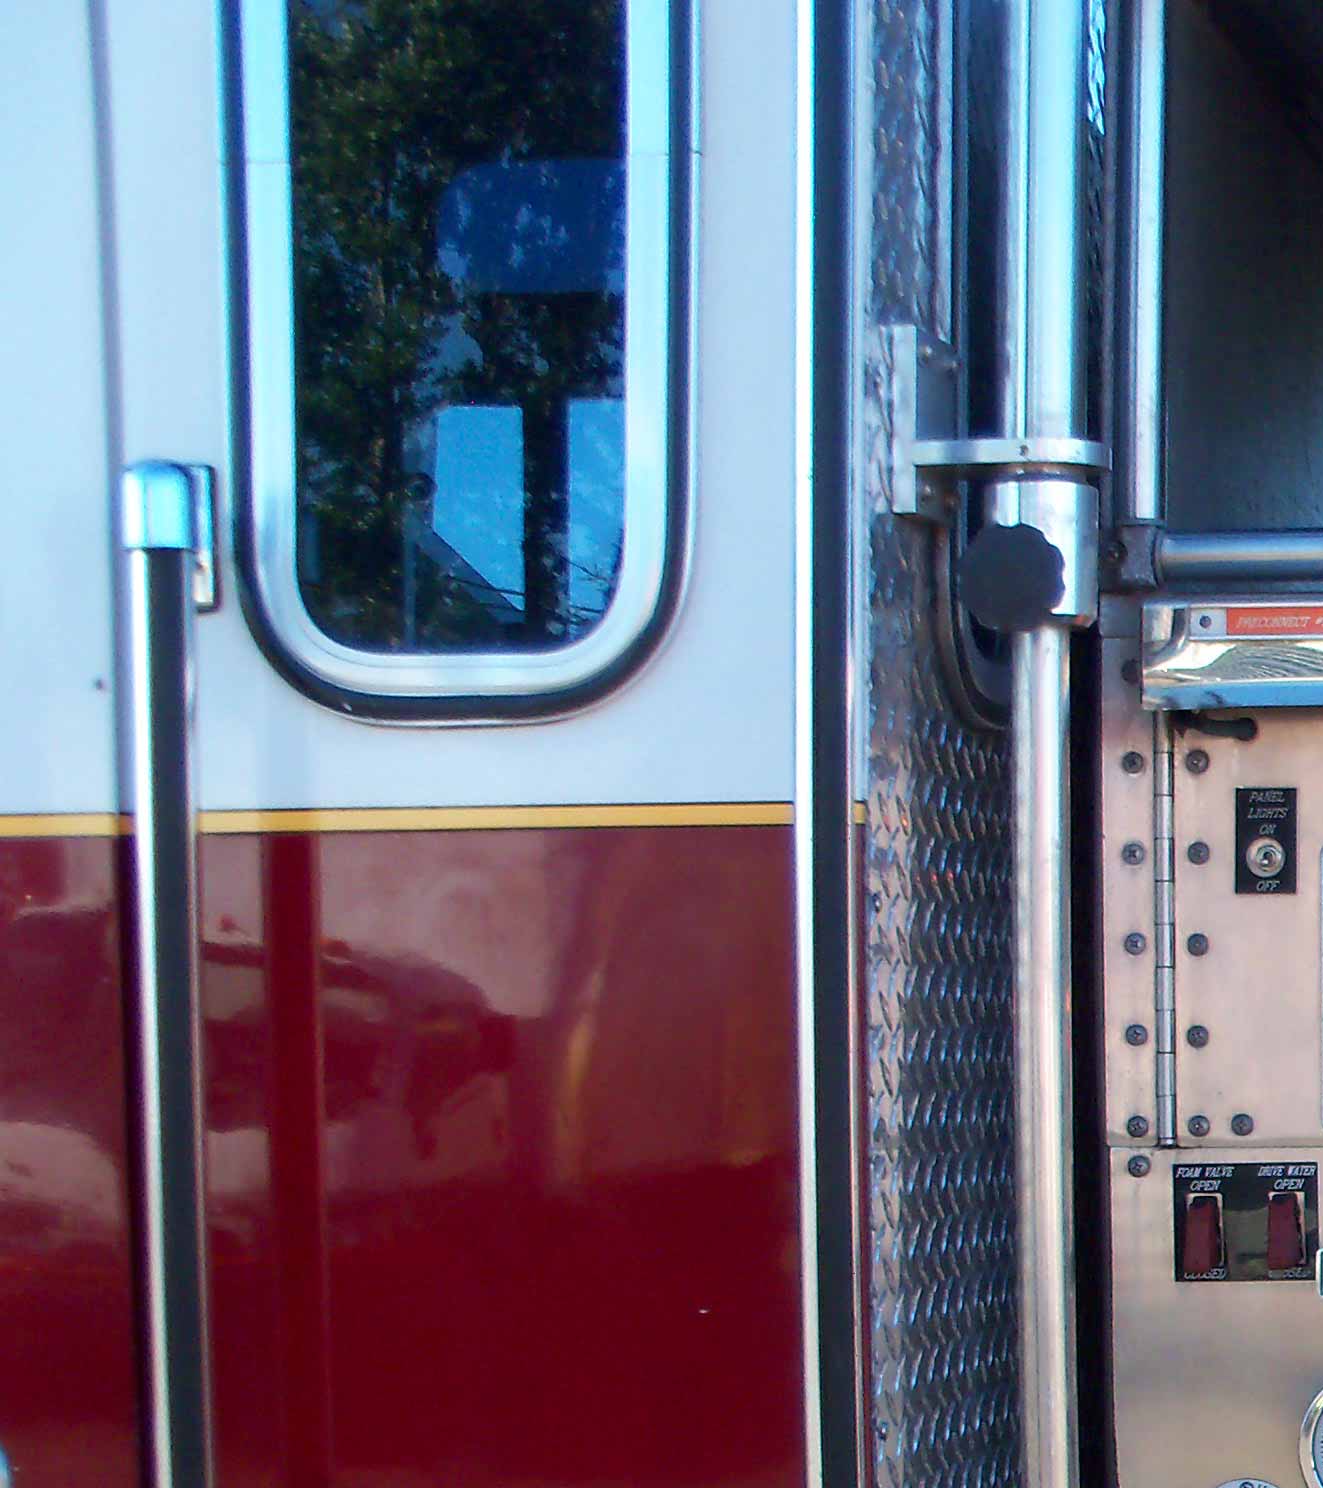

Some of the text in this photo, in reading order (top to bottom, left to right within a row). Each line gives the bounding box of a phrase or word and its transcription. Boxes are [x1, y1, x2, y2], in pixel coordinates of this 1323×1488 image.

[1236, 616, 1310, 628] PRECONNECT
[1249, 791, 1285, 803] PANEL
[1248, 807, 1288, 820] LIGHTS
[1259, 824, 1276, 835] ON
[1256, 880, 1280, 892] OFF
[1175, 1166, 1235, 1178] FOAM VALVE
[1257, 1165, 1316, 1177] DRIVE WATER
[1190, 1180, 1221, 1191] OPEN
[1273, 1179, 1305, 1190] OPEN
